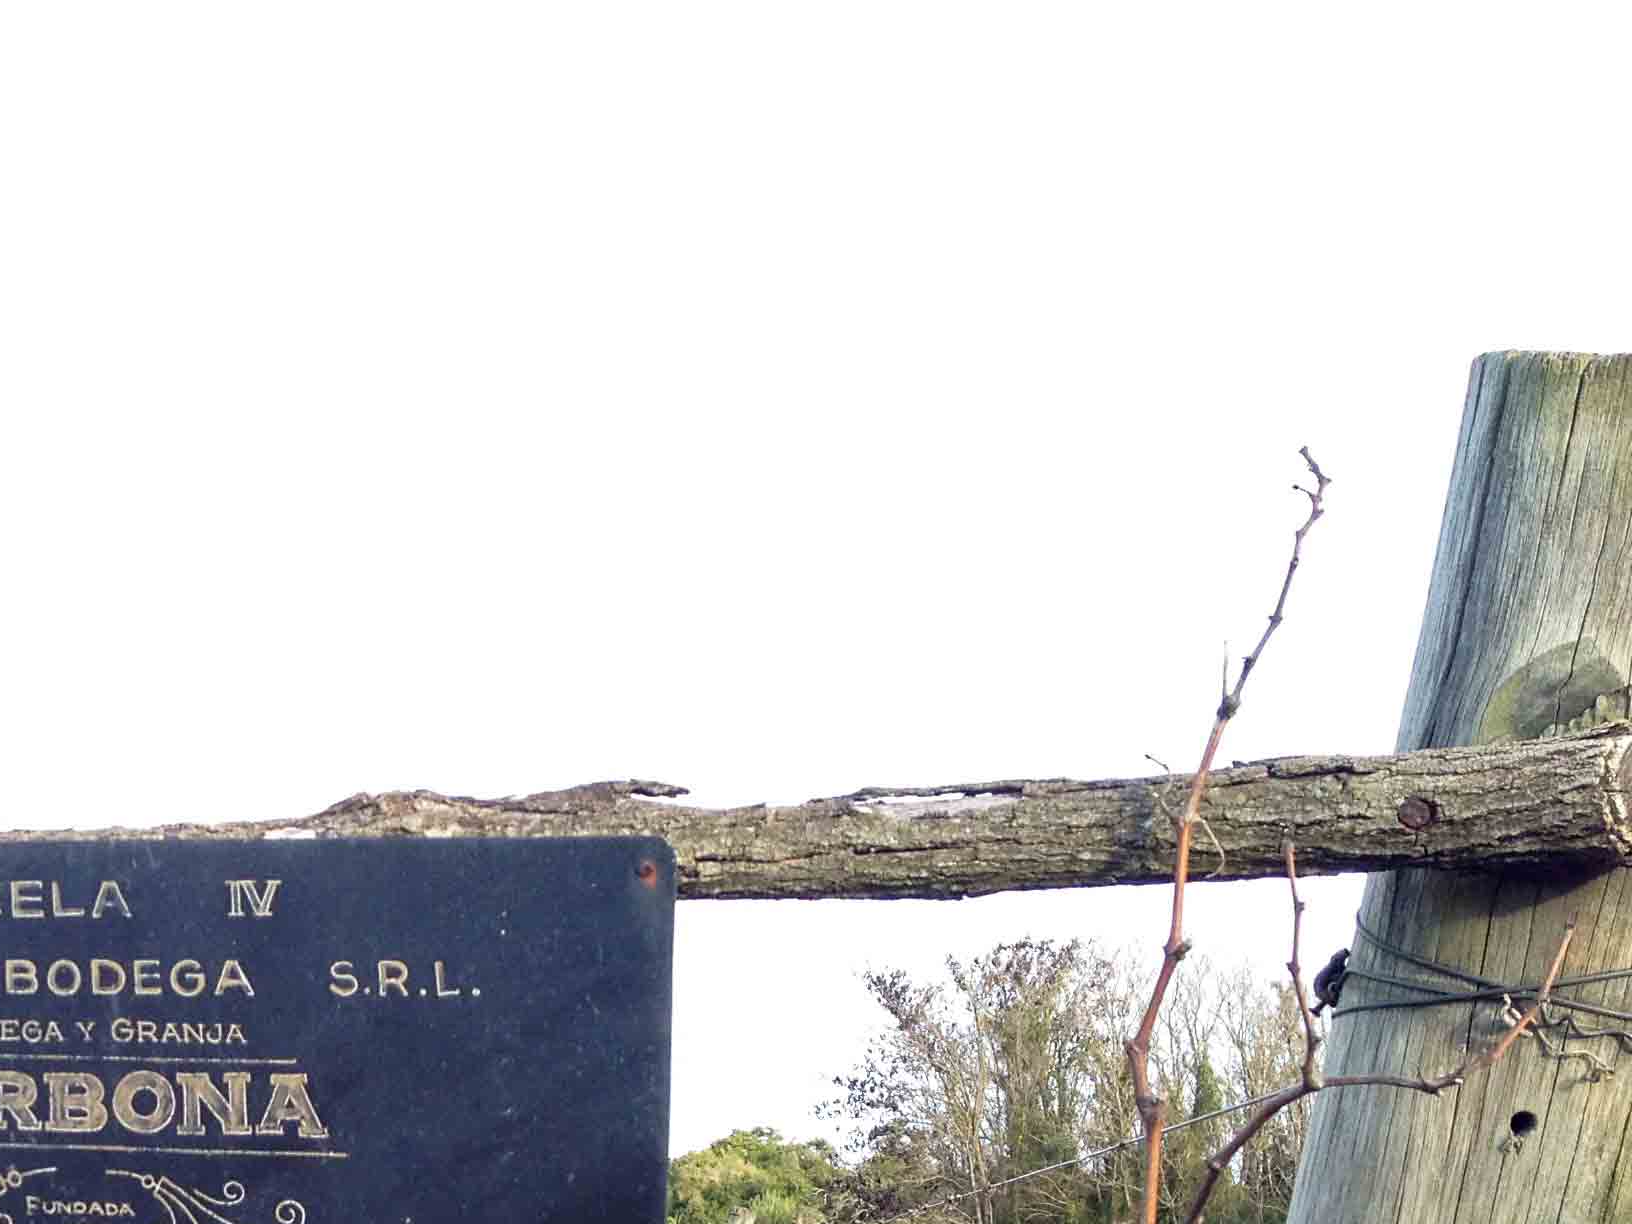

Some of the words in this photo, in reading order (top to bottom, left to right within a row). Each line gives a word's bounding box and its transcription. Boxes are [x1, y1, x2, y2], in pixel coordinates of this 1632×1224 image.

[224, 879, 282, 918] IV
[4, 958, 255, 998] BODEGA
[329, 959, 481, 998] S.R.L.
[75, 1021, 96, 1042] Y
[110, 1017, 248, 1045] GRANJA
[25, 1195, 136, 1217] FUNDADA
